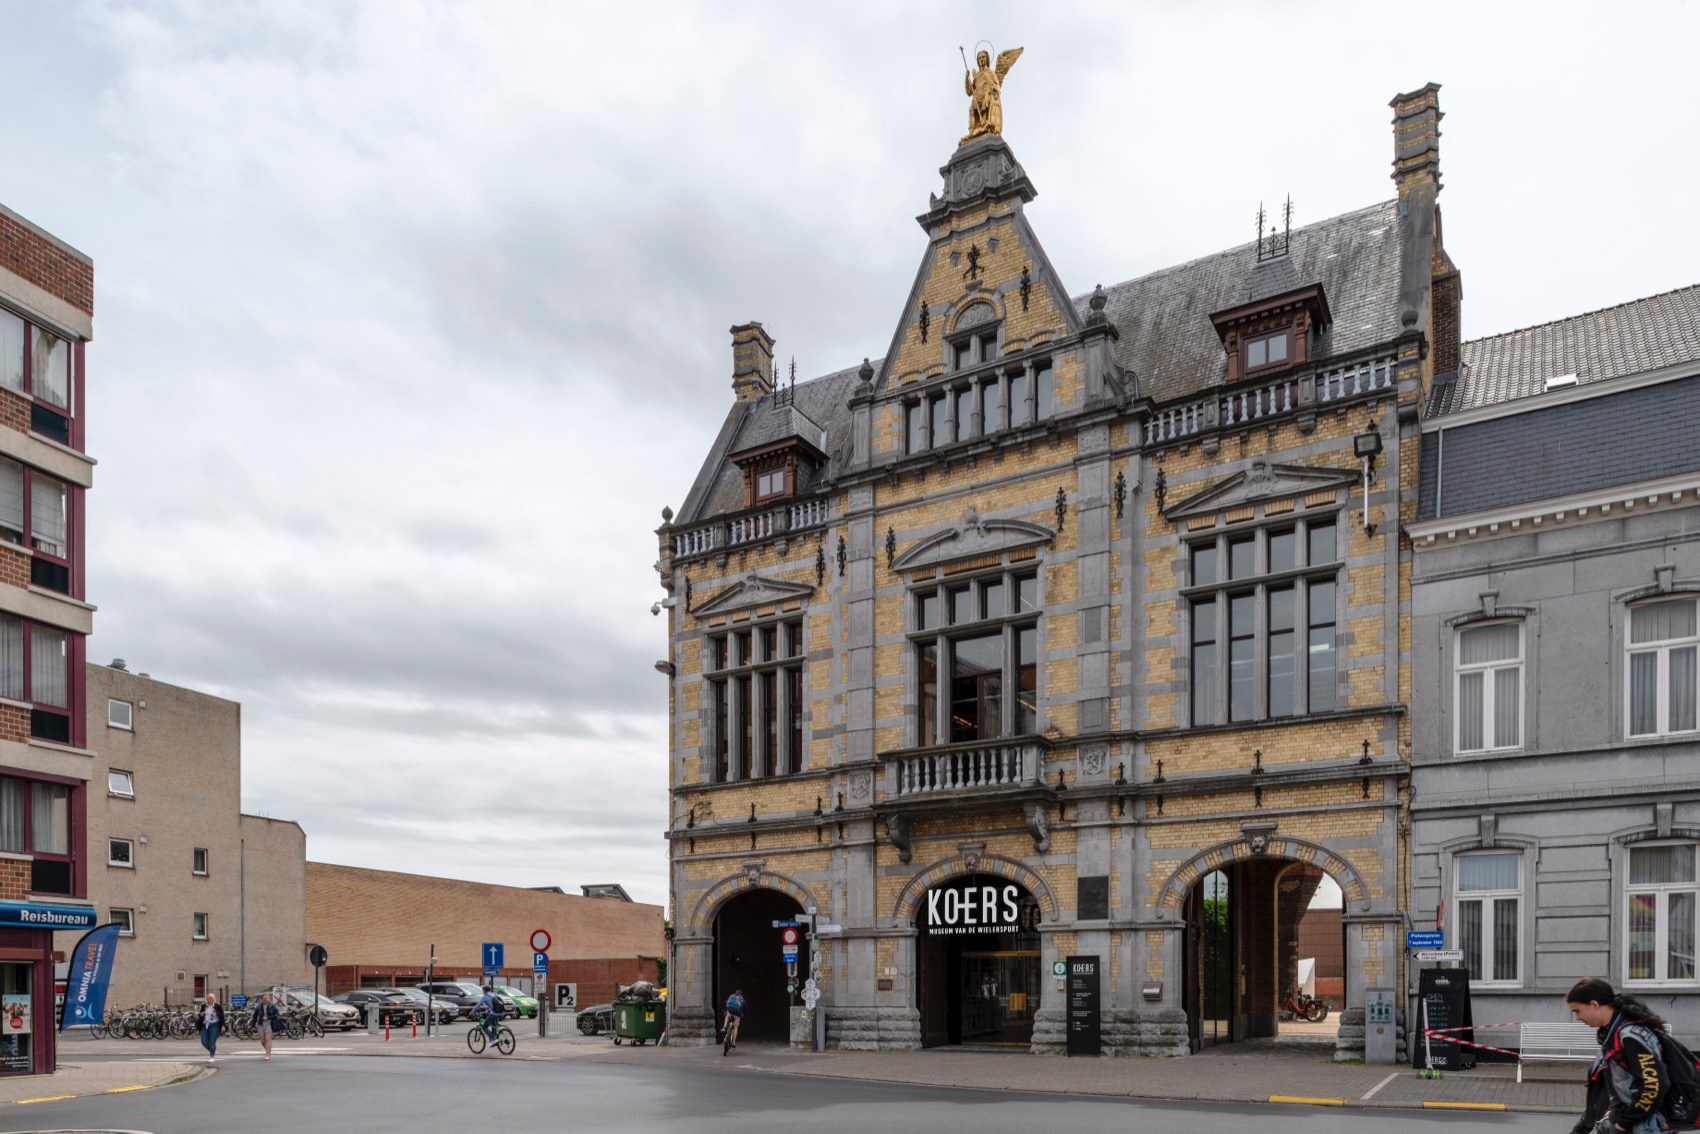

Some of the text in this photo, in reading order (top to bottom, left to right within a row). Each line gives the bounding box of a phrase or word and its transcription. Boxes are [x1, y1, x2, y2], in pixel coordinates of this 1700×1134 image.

[928, 885, 1018, 925] KOERS
[20, 909, 89, 925] Reisbureau
[929, 927, 954, 935] MUSEUM
[977, 925, 1019, 933] WIELERSPORT
[536, 955, 543, 965] P
[1073, 963, 1094, 972] KOERS
[78, 943, 98, 1002] OMNIA TRAVEL
[1634, 1053, 1660, 1112] ALCATRAZ
